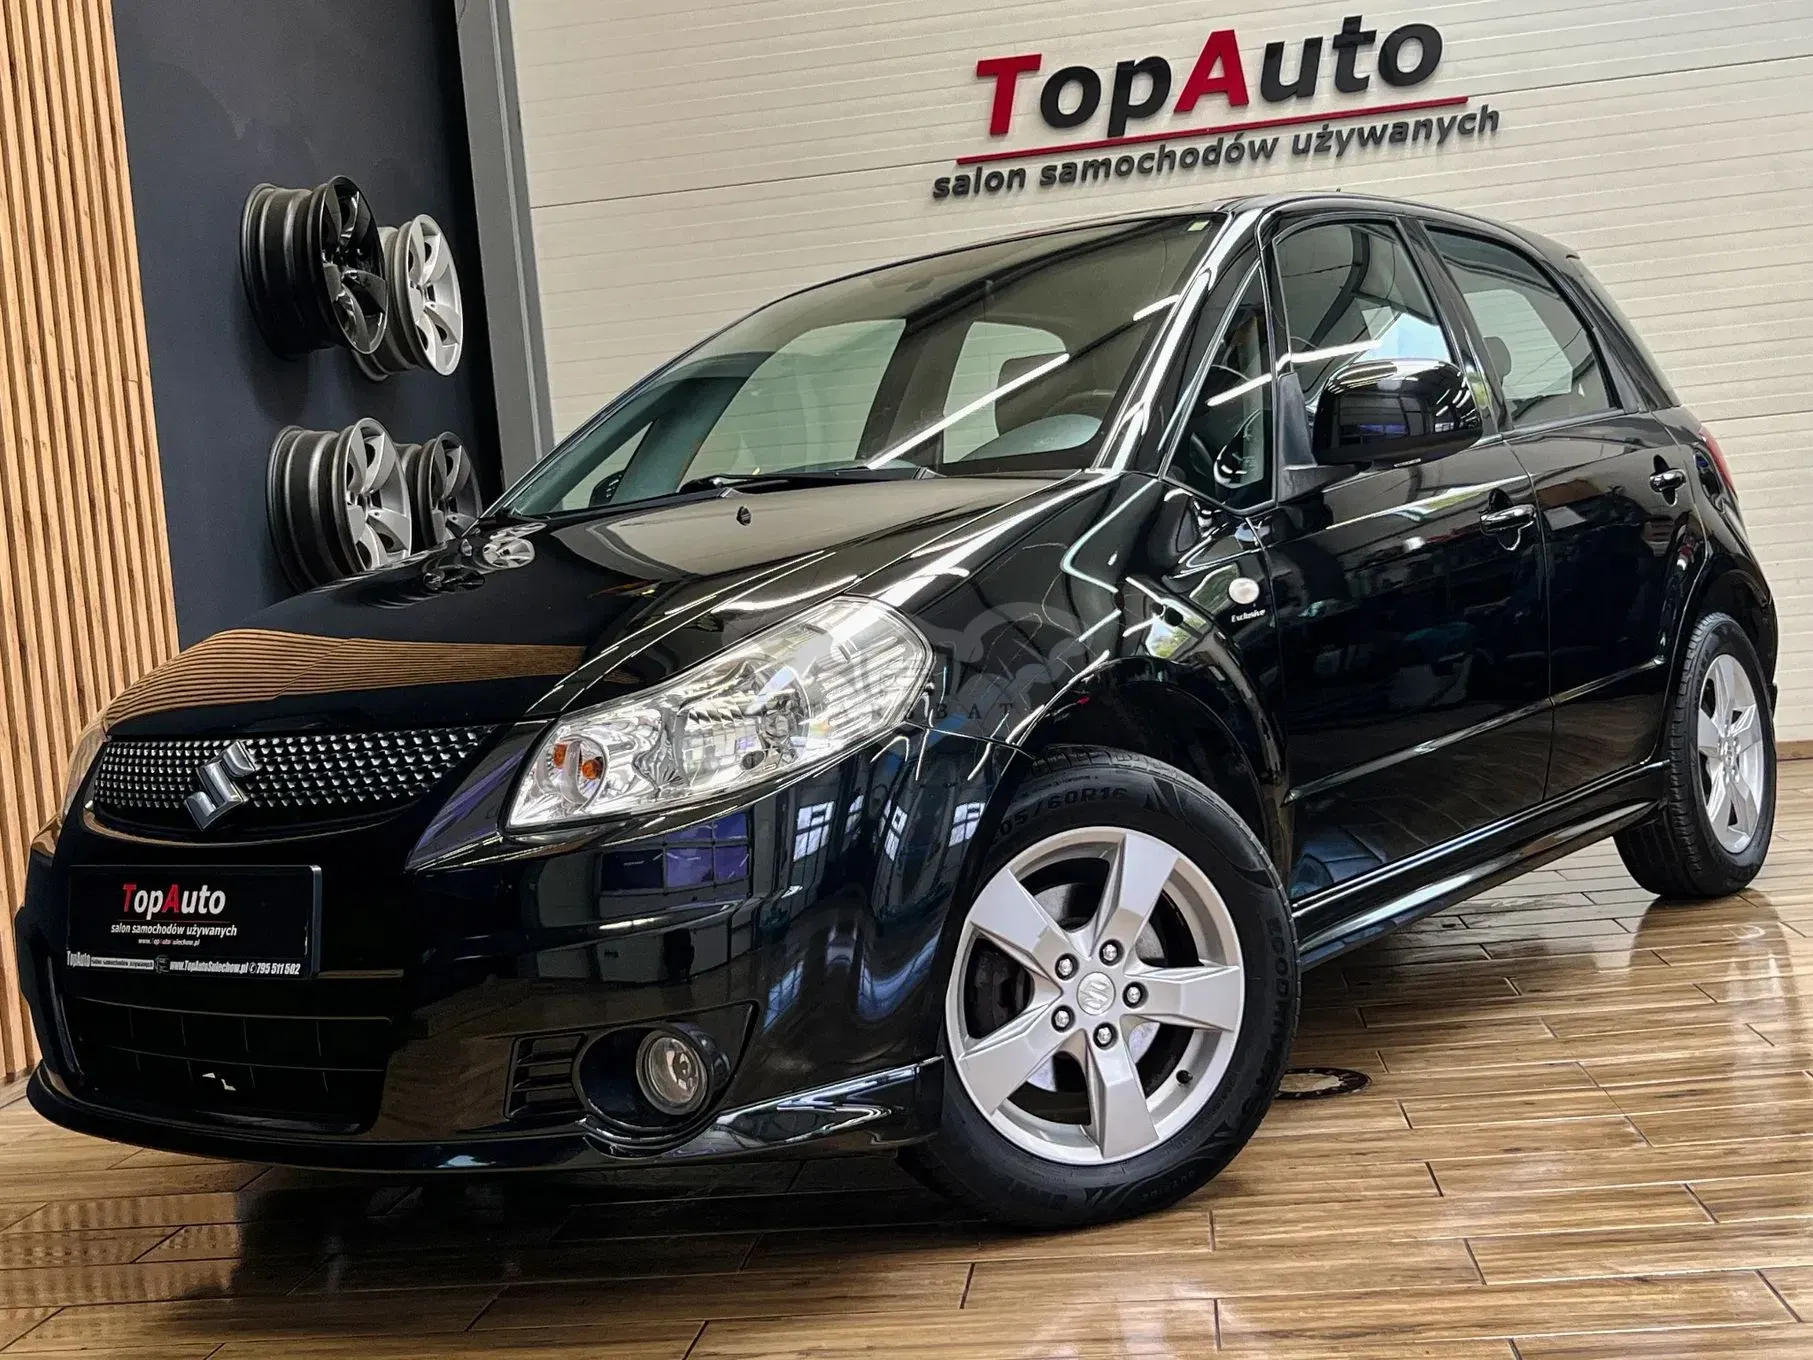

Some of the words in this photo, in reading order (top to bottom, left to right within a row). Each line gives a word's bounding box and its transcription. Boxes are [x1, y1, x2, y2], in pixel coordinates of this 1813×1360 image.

[976, 15, 1443, 137] TopAuto
[933, 166, 1027, 198] salon
[1040, 131, 1279, 187] samochodów
[1292, 104, 1500, 157] używanych
[110, 922, 131, 934] salon
[131, 922, 186, 935] samochodów
[186, 924, 238, 939] używanych
[122, 884, 226, 921] TopAuto
